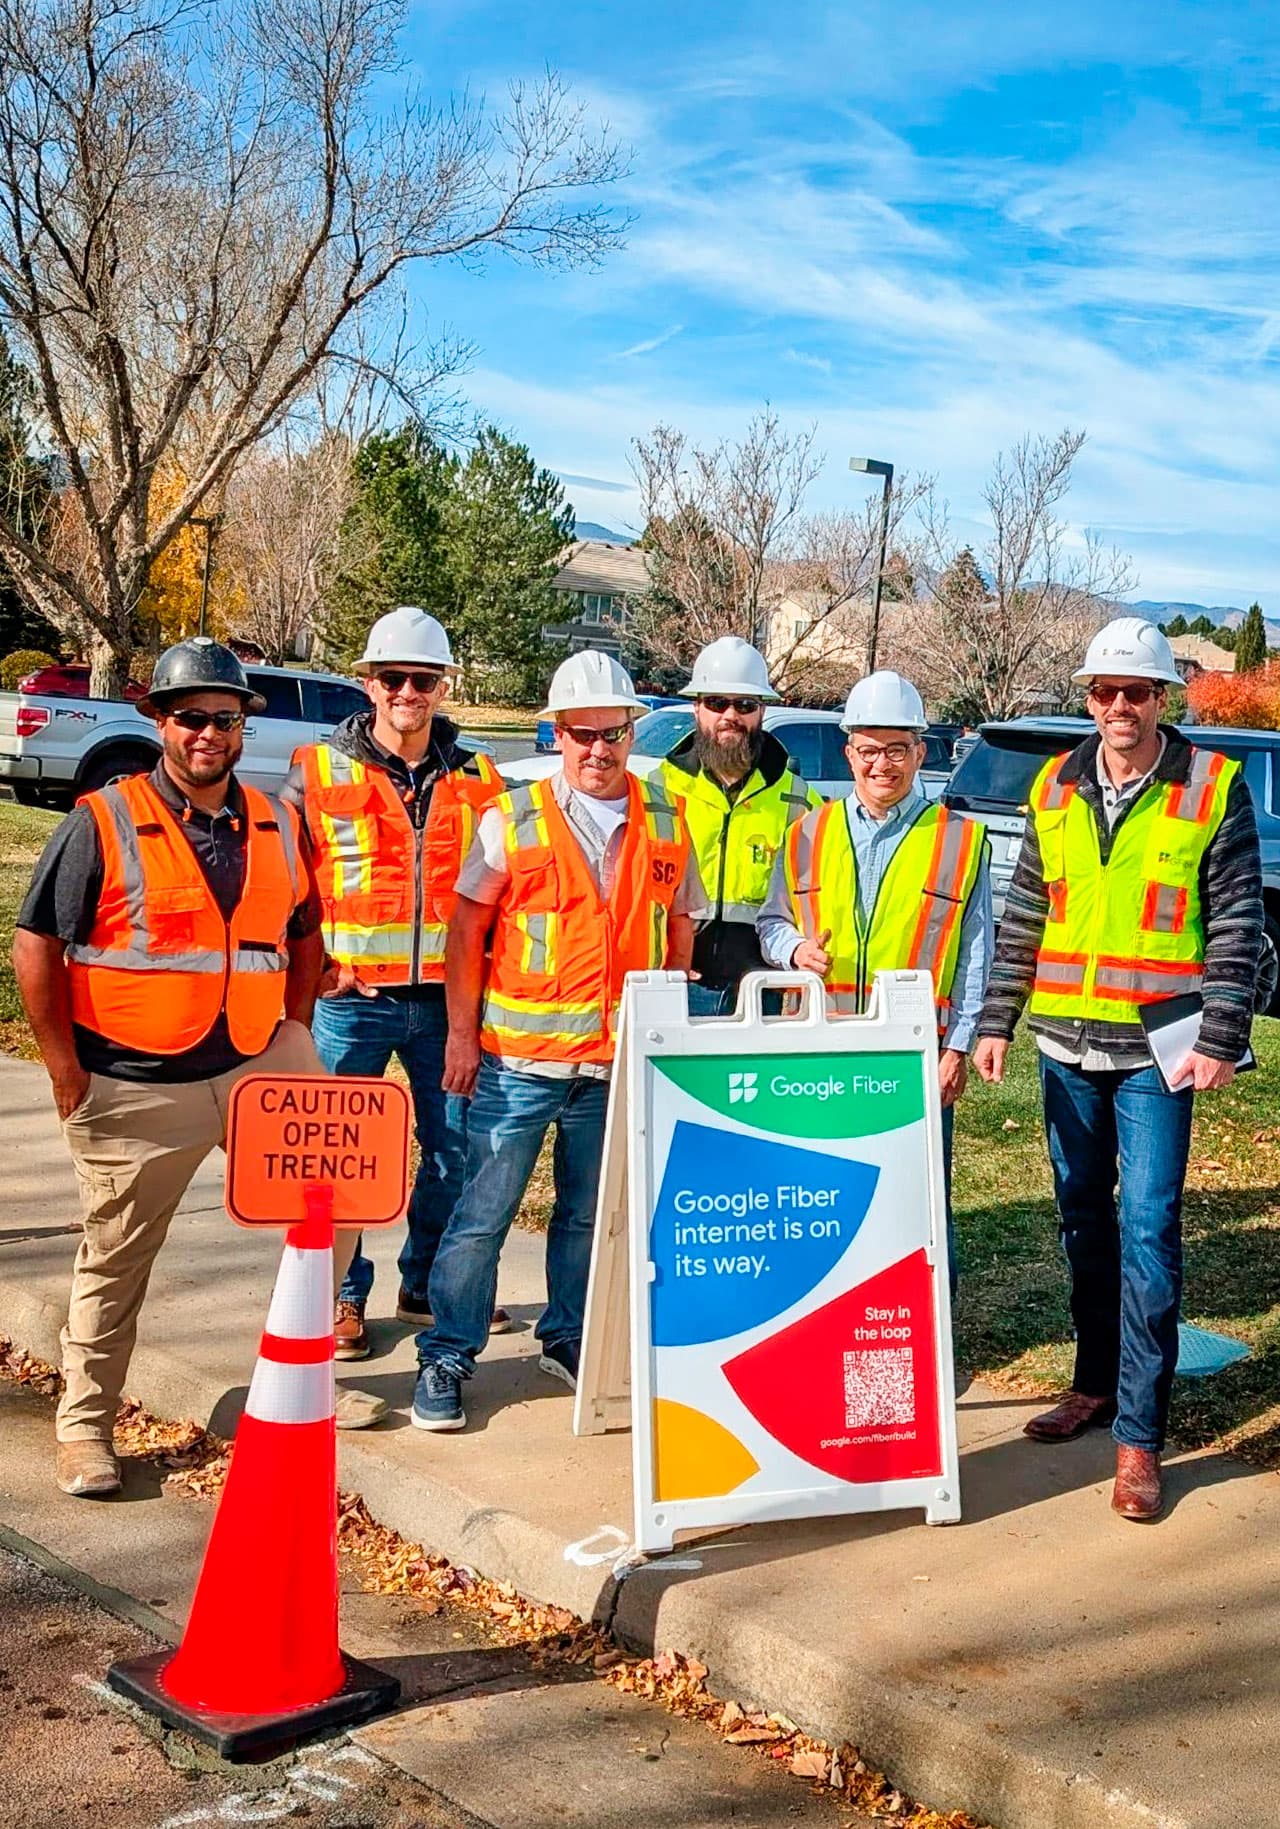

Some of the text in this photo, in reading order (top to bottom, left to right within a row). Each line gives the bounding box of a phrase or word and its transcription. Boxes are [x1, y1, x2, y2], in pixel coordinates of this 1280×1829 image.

[55, 709, 97, 721] FX4
[770, 1075, 900, 1100] Google Fiber
[261, 1088, 385, 1115] CAUTION
[284, 1122, 360, 1148] OPEN
[264, 1154, 377, 1180] TRENCH
[674, 1186, 840, 1217] Google Fiber
[675, 1217, 840, 1245] internet is on
[675, 1254, 770, 1279] its way.
[865, 1305, 910, 1322] Stay in
[854, 1325, 911, 1341] the loop
